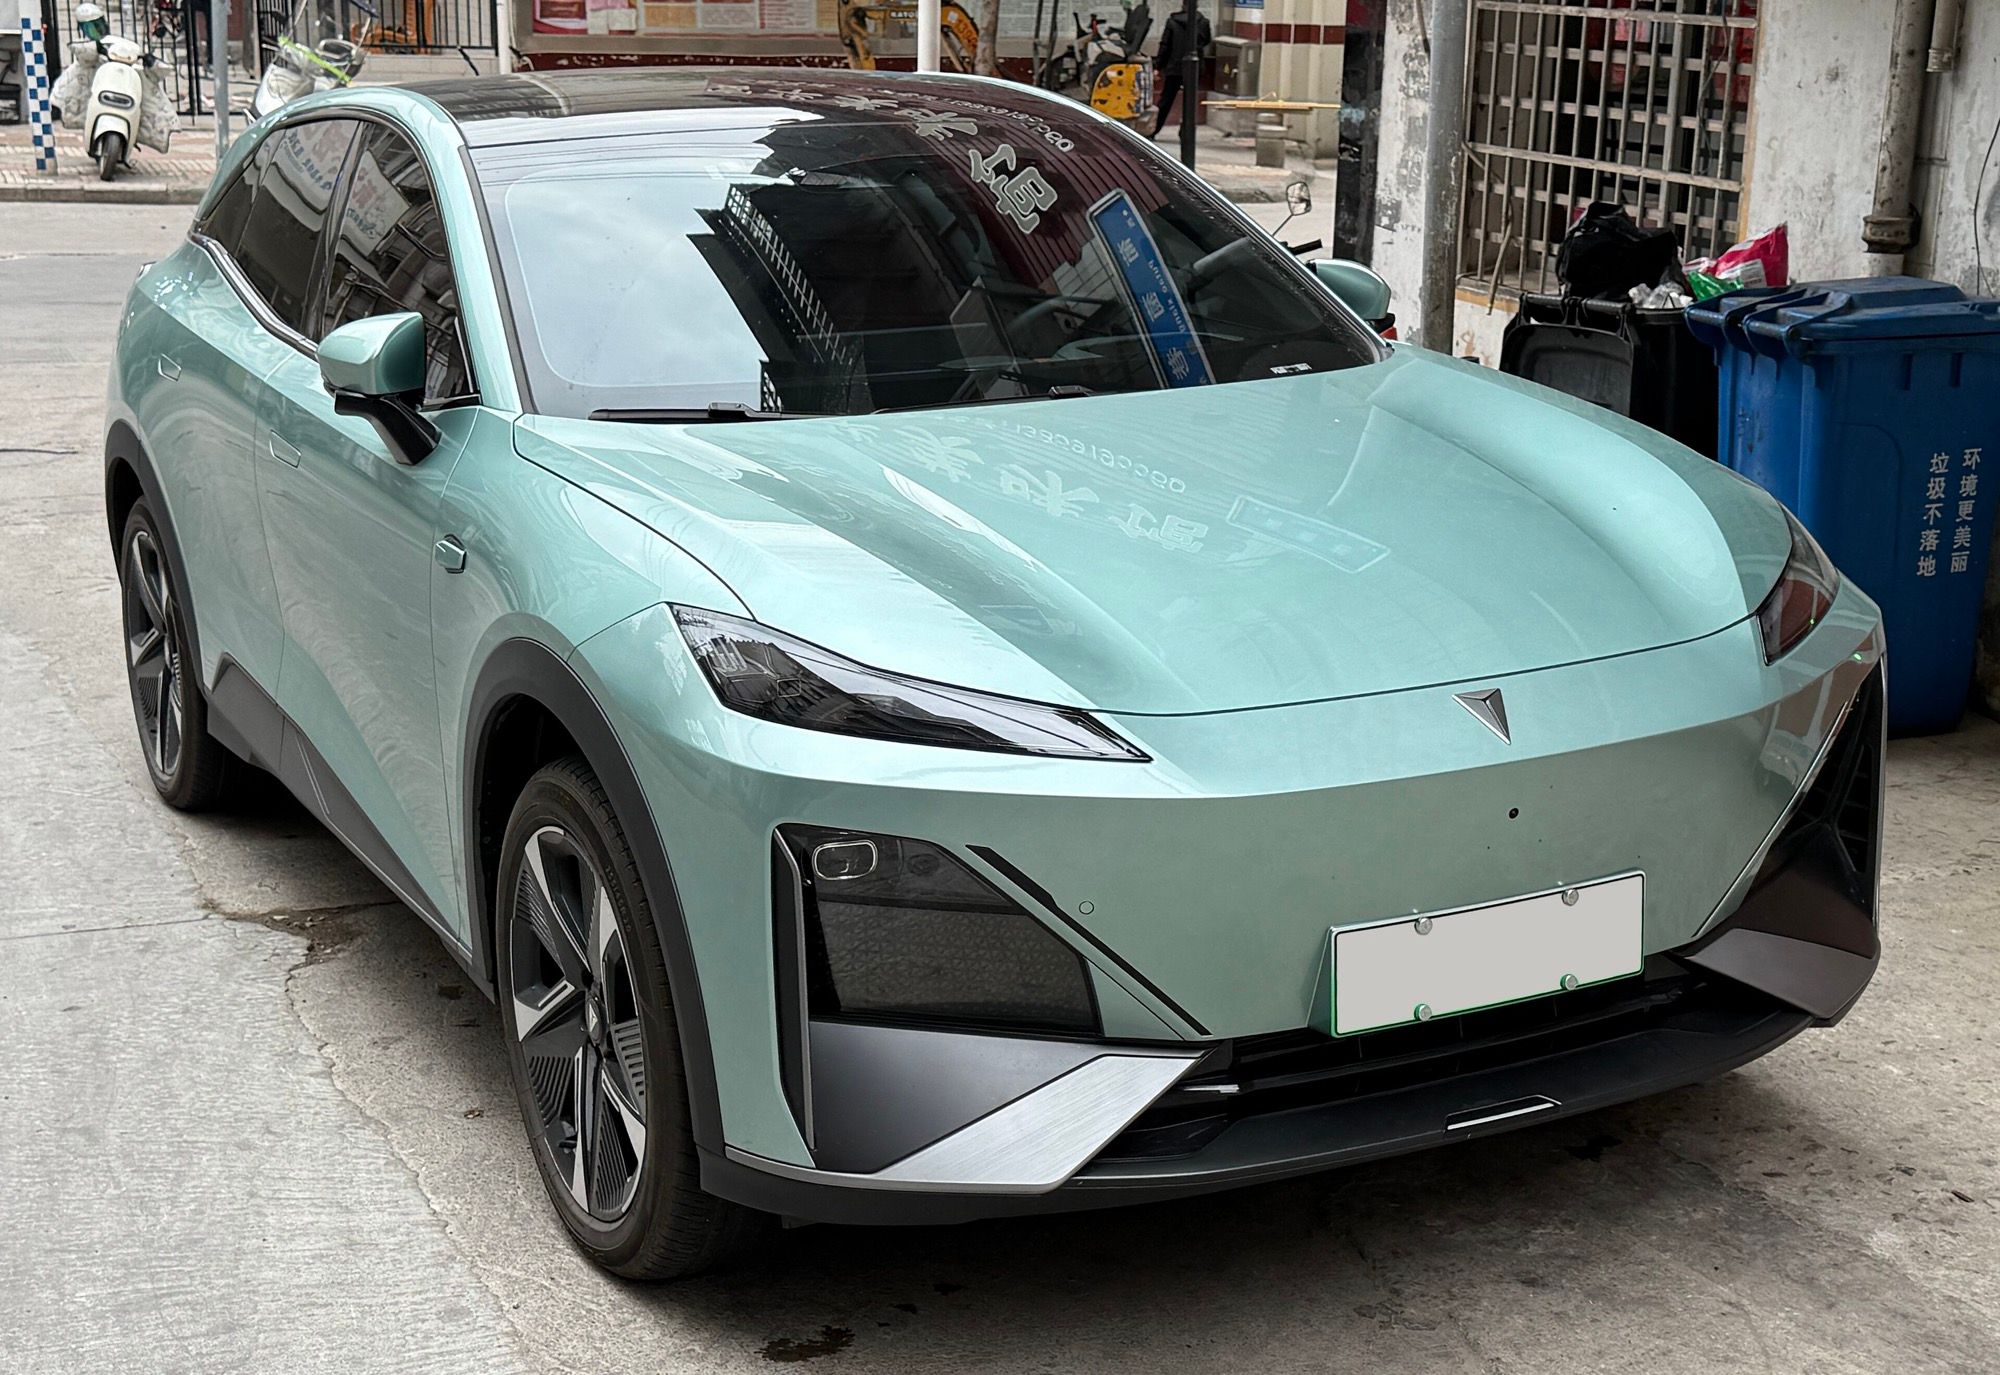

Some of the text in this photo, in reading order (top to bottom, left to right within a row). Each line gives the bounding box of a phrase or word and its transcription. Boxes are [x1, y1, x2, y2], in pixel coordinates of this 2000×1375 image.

[1916, 452, 1950, 577] 垃圾不落地
[1950, 447, 1982, 573] 环境更美丽
